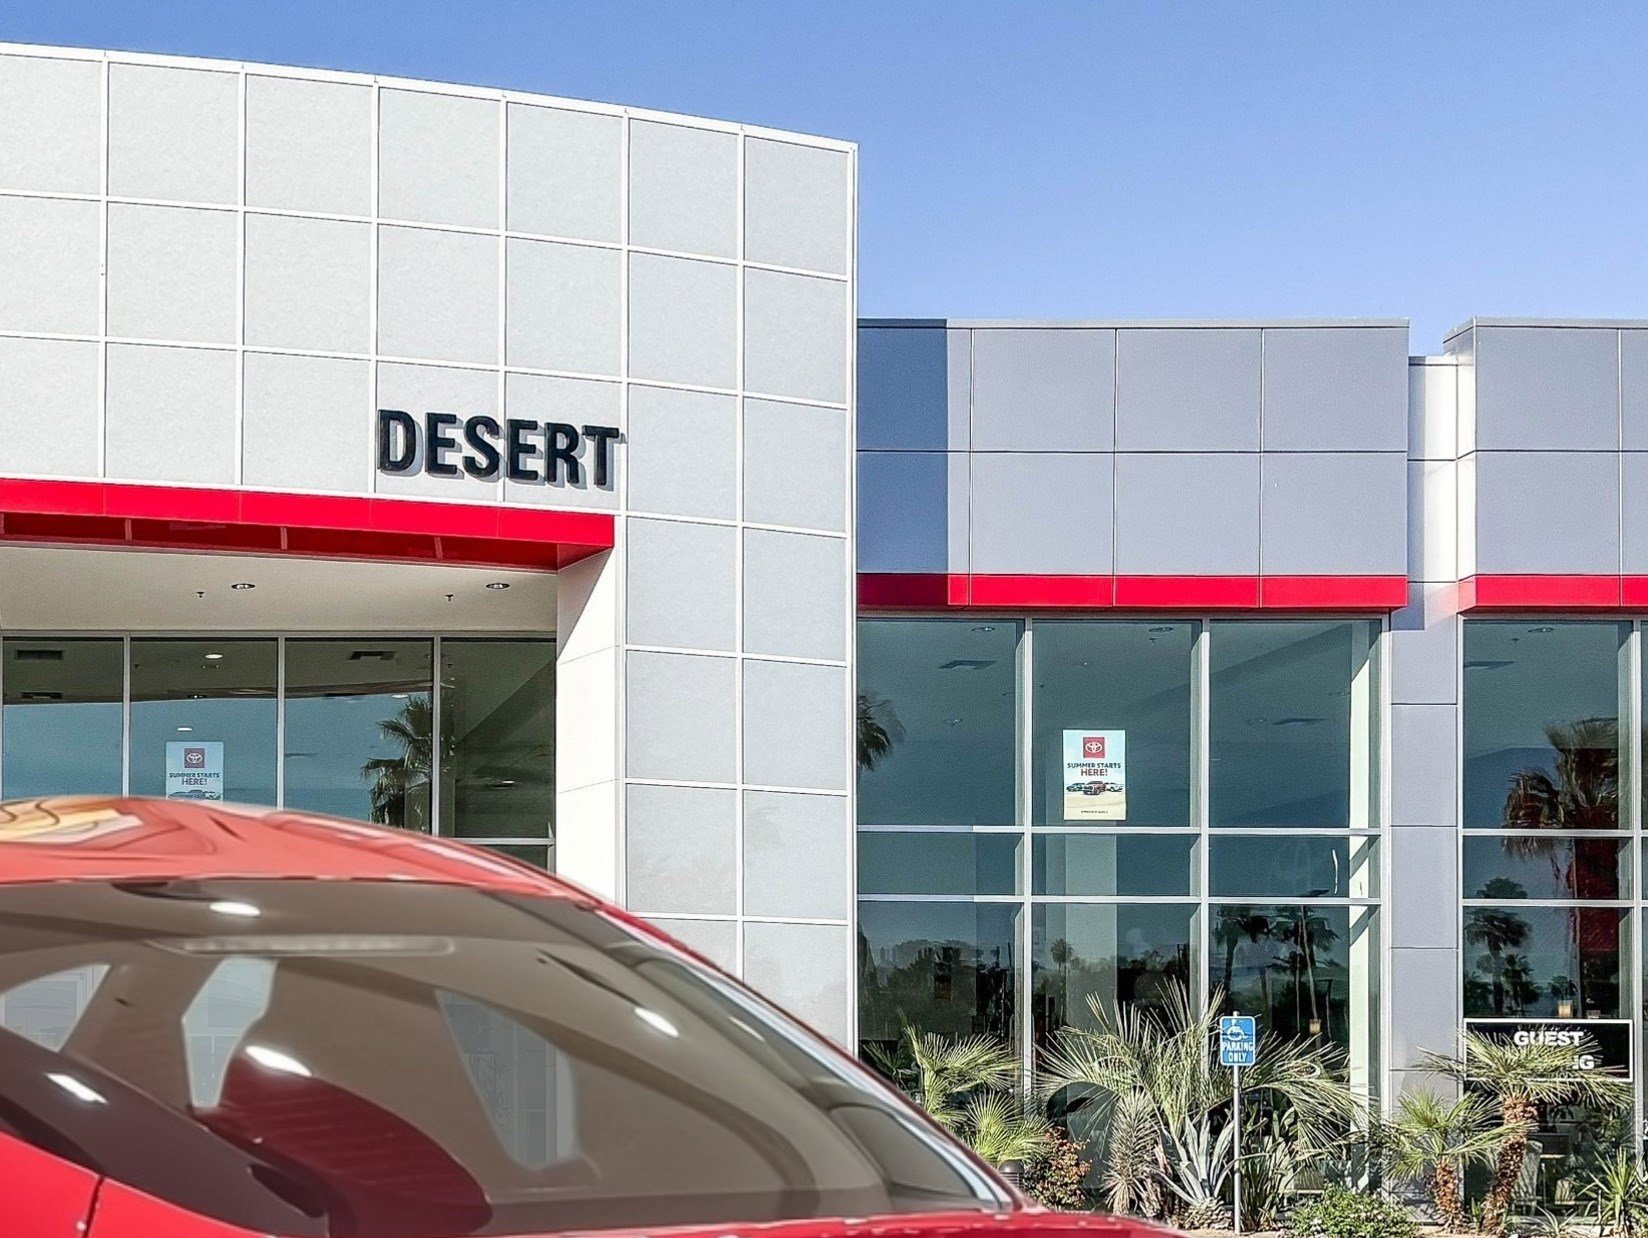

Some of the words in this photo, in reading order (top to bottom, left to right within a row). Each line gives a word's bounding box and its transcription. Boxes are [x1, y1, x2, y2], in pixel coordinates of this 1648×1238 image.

[377, 409, 620, 487] DESERT
[1513, 1031, 1584, 1046] GUEST
[1222, 1041, 1254, 1051] PARKING
[1228, 1052, 1247, 1062] ONLY
